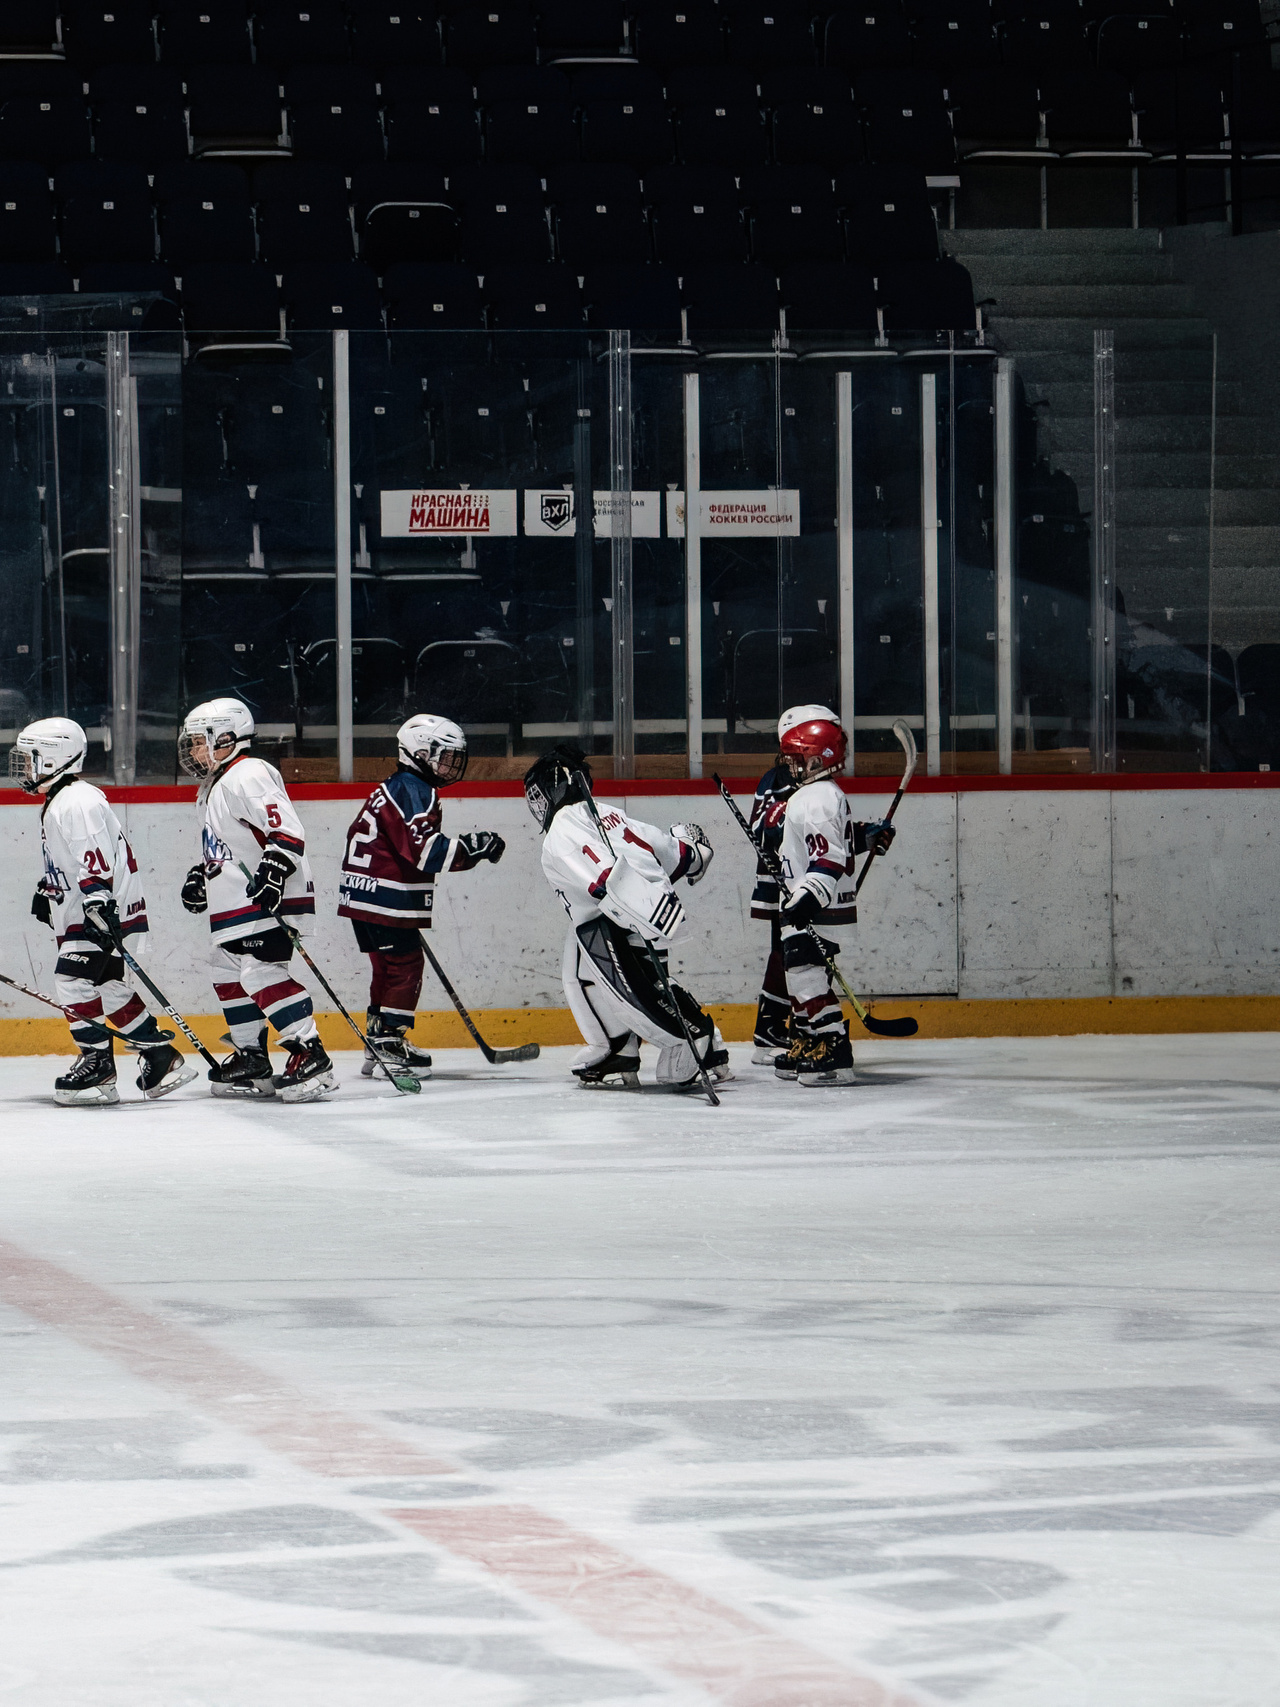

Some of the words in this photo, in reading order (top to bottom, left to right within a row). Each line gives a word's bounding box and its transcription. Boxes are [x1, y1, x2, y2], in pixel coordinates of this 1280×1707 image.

[411, 494, 472, 508] КРАСНАЯ
[709, 503, 767, 514] ФЕДЕРАЦИЯ
[409, 508, 490, 527] МАШИНА
[542, 503, 569, 520] ВХЛ
[709, 515, 748, 524] ХОККЕЯ
[265, 803, 282, 828] 5
[582, 845, 601, 864] 1
